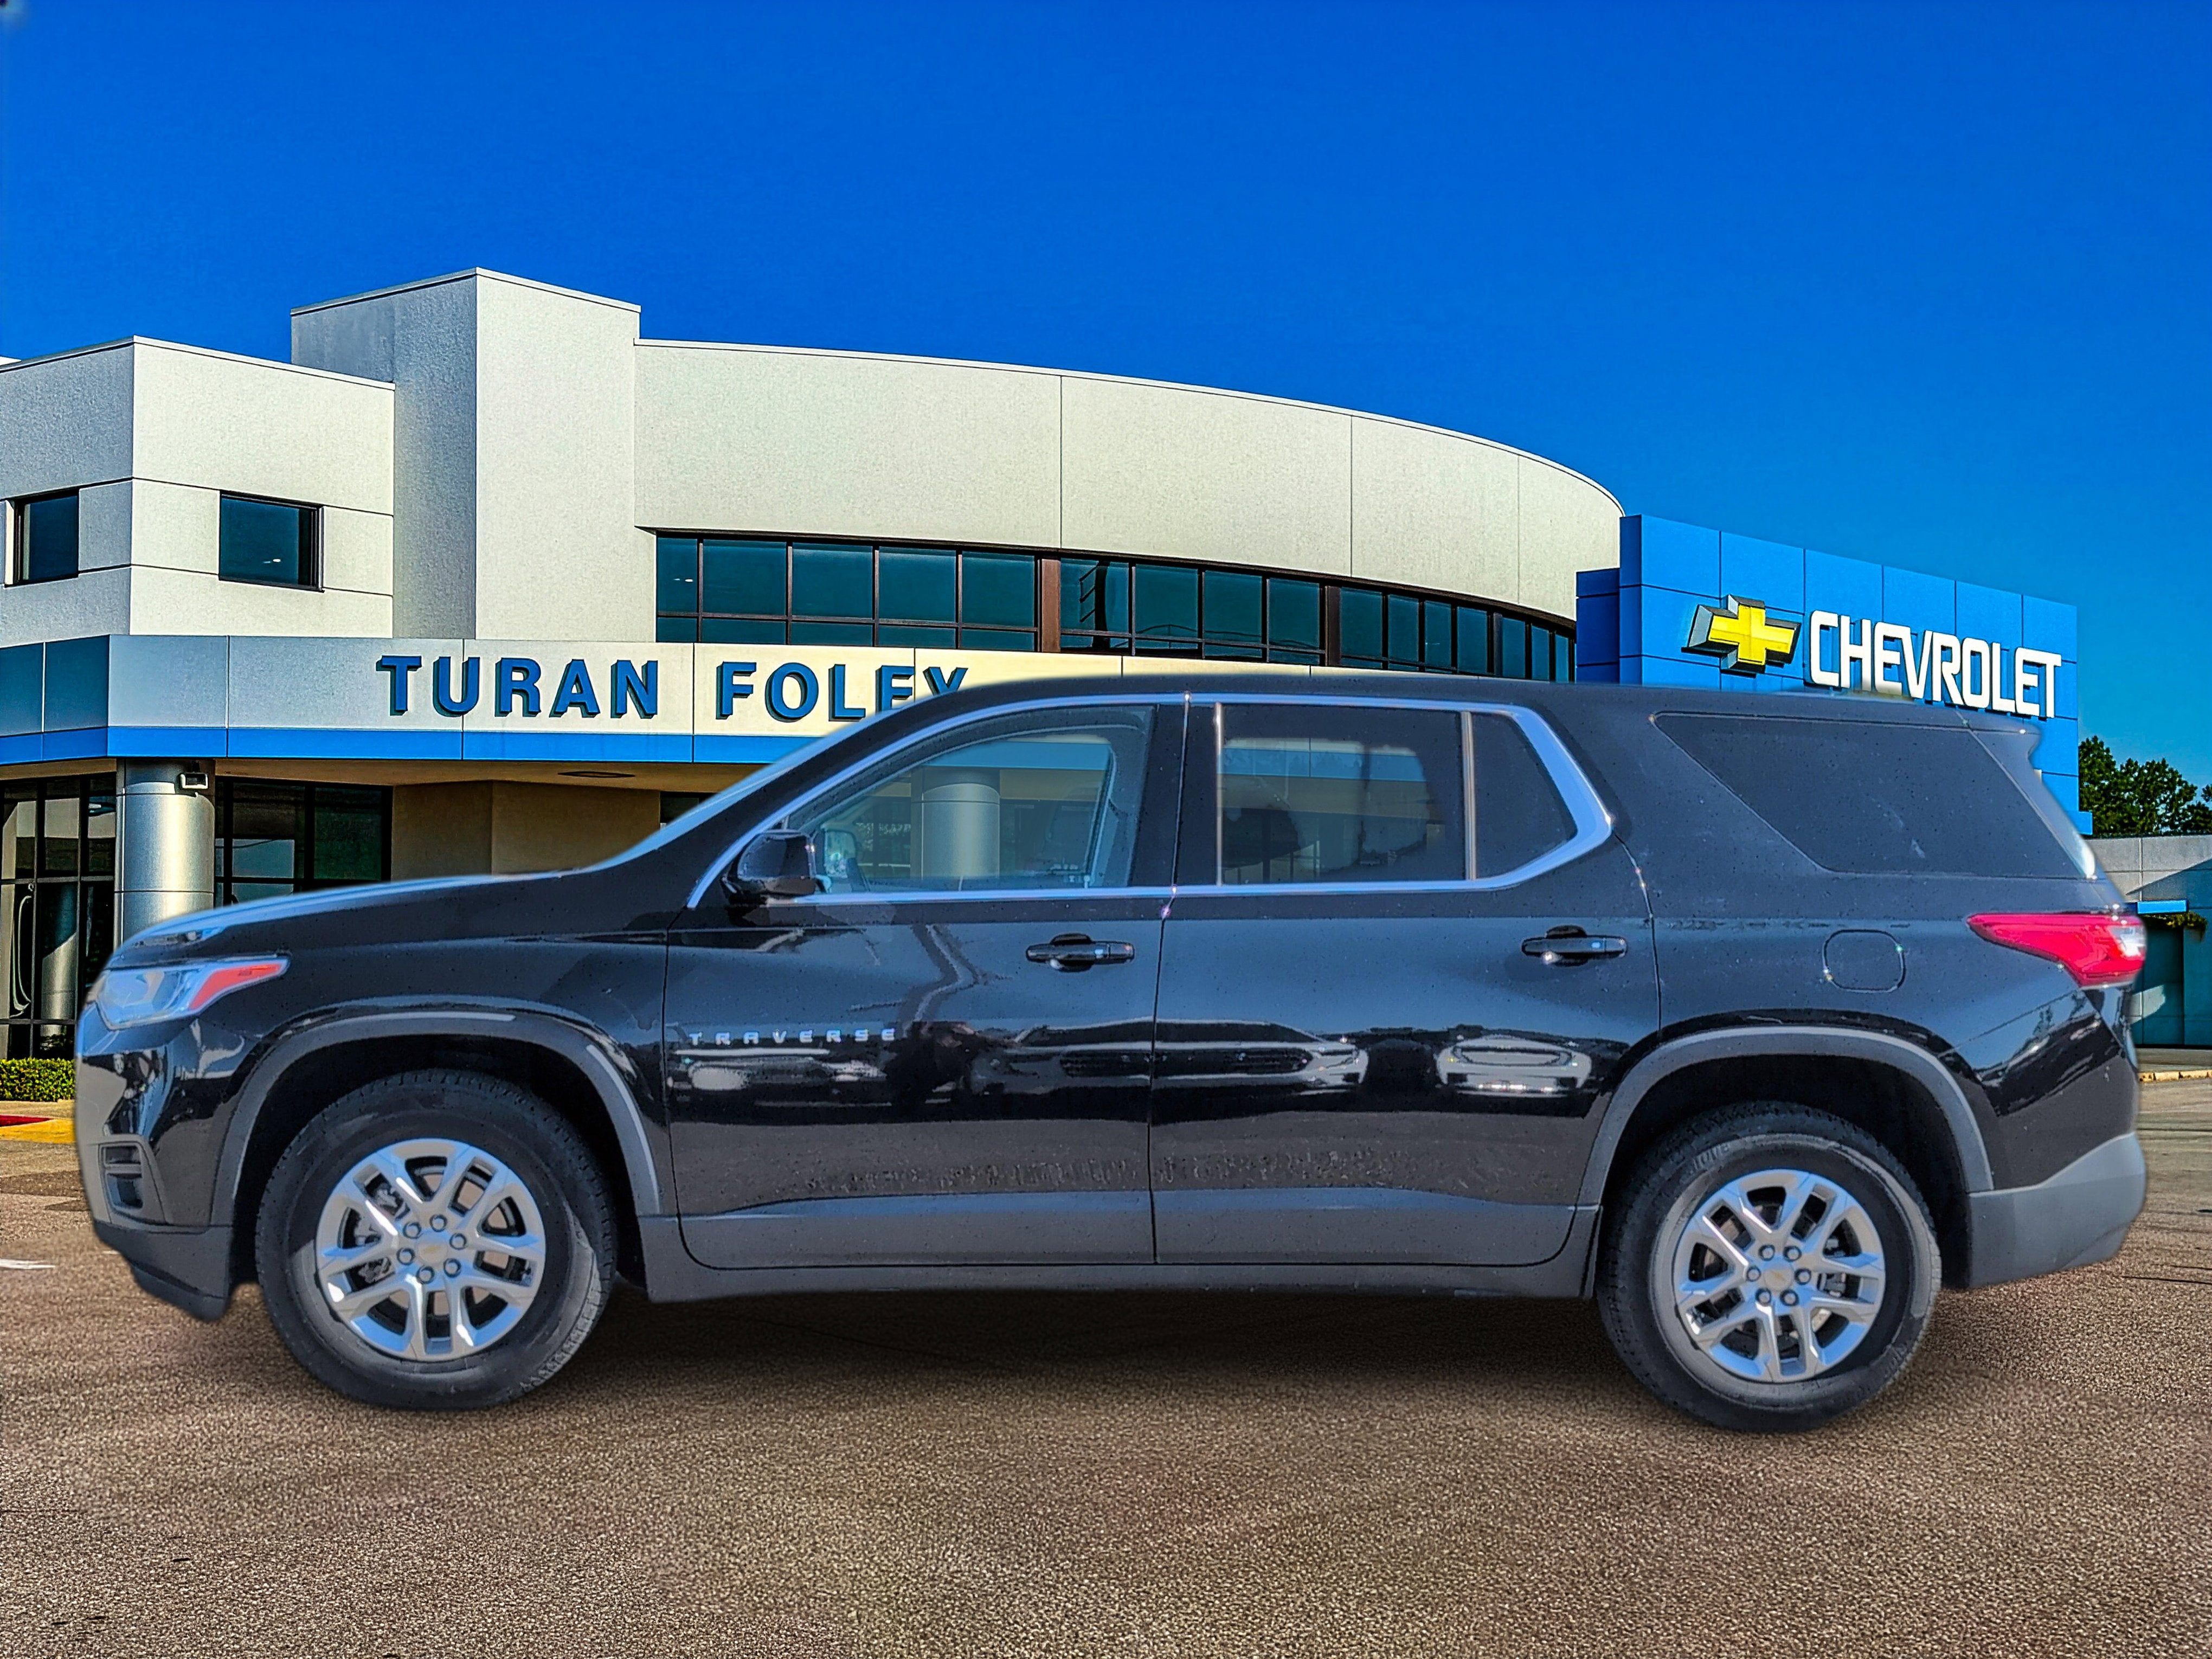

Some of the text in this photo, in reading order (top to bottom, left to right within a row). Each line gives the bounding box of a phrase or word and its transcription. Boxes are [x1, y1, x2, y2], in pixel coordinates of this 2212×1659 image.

[376, 655, 658, 718] TURAN
[1810, 610, 2062, 718] CHEVROLET
[689, 1028, 895, 1046] TRAVERSE
